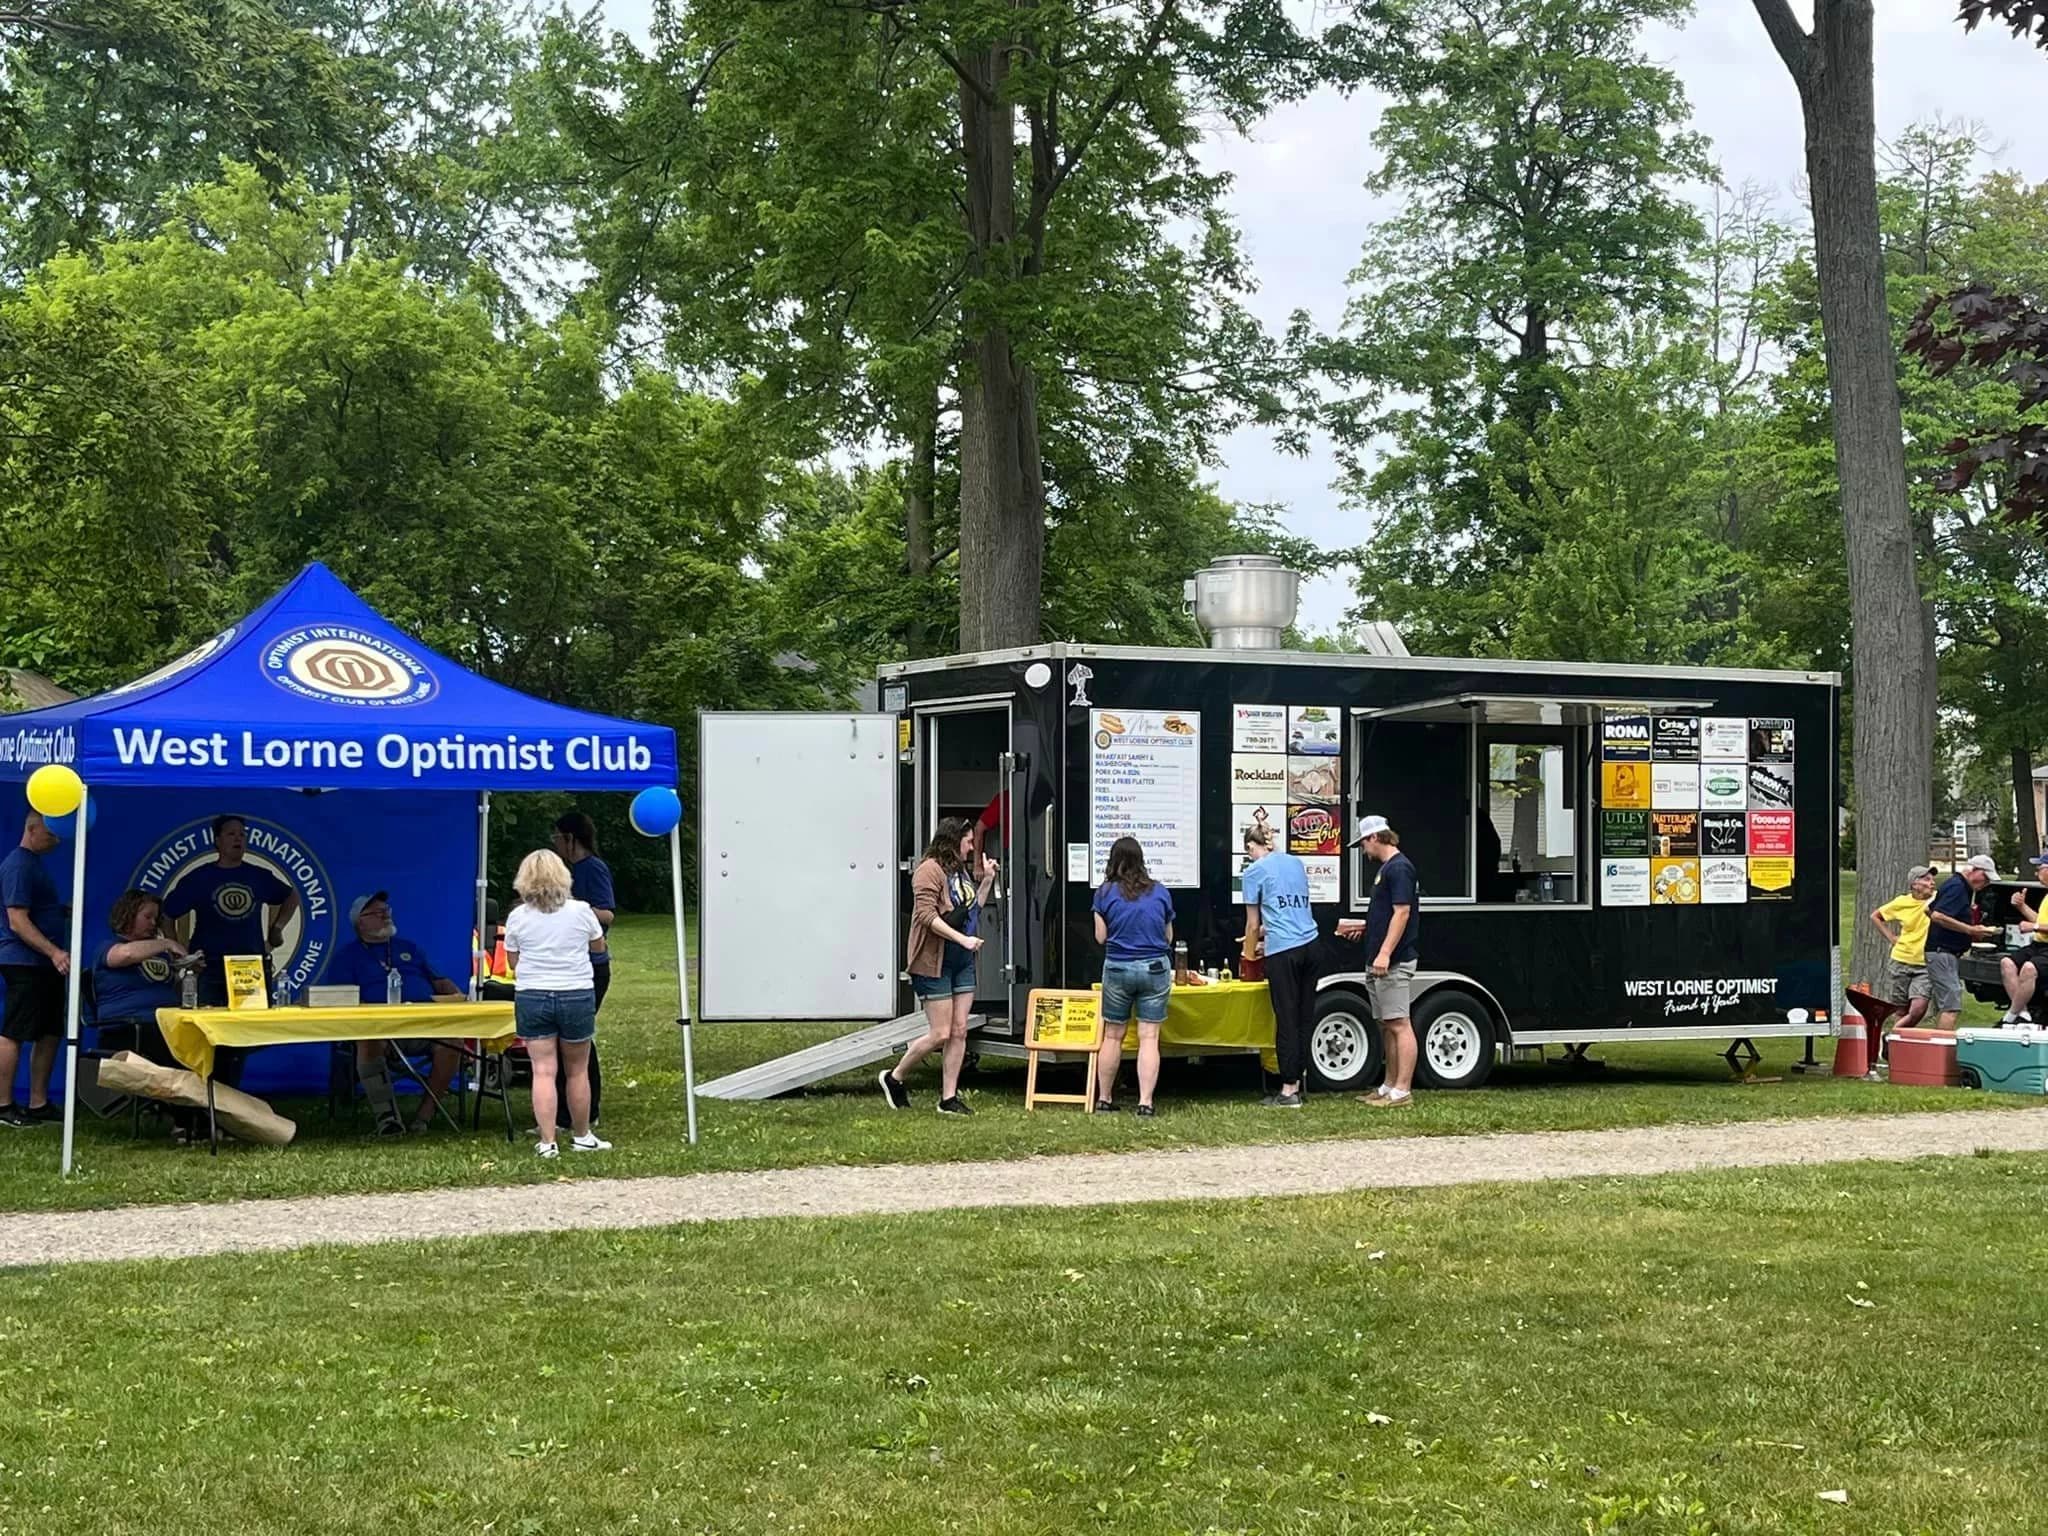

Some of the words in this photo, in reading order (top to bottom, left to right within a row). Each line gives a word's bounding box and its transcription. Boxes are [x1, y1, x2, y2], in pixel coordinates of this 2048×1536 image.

[268, 632, 310, 669] OPTIMIST
[310, 628, 425, 676] INTERNATIONAL
[276, 675, 329, 700] OPTIMIST
[331, 696, 366, 705] CLUB
[1605, 725, 1648, 738] RONA
[16, 729, 53, 770] Optimist
[54, 725, 75, 763] Club
[113, 727, 228, 767] West
[242, 731, 364, 769] Lorne
[376, 733, 555, 777] Optimist
[565, 736, 652, 771] Club
[1235, 768, 1284, 781] Rockland
[1606, 812, 1645, 823] UTLEY
[1652, 813, 1697, 824] NATTERJACK
[1658, 823, 1692, 834] BREWING
[140, 833, 197, 892] TIMIST
[203, 826, 328, 920] IRNATIONAL
[1306, 866, 1332, 874] EAK
[1606, 864, 1618, 877] IG
[1624, 981, 1664, 996] WEST
[1666, 979, 1713, 996] LORNE
[1715, 978, 1778, 995] OPTIMIST
[1664, 997, 1699, 1016] Friend
[1700, 996, 1711, 1015] of
[1712, 993, 1740, 1014] Youth
